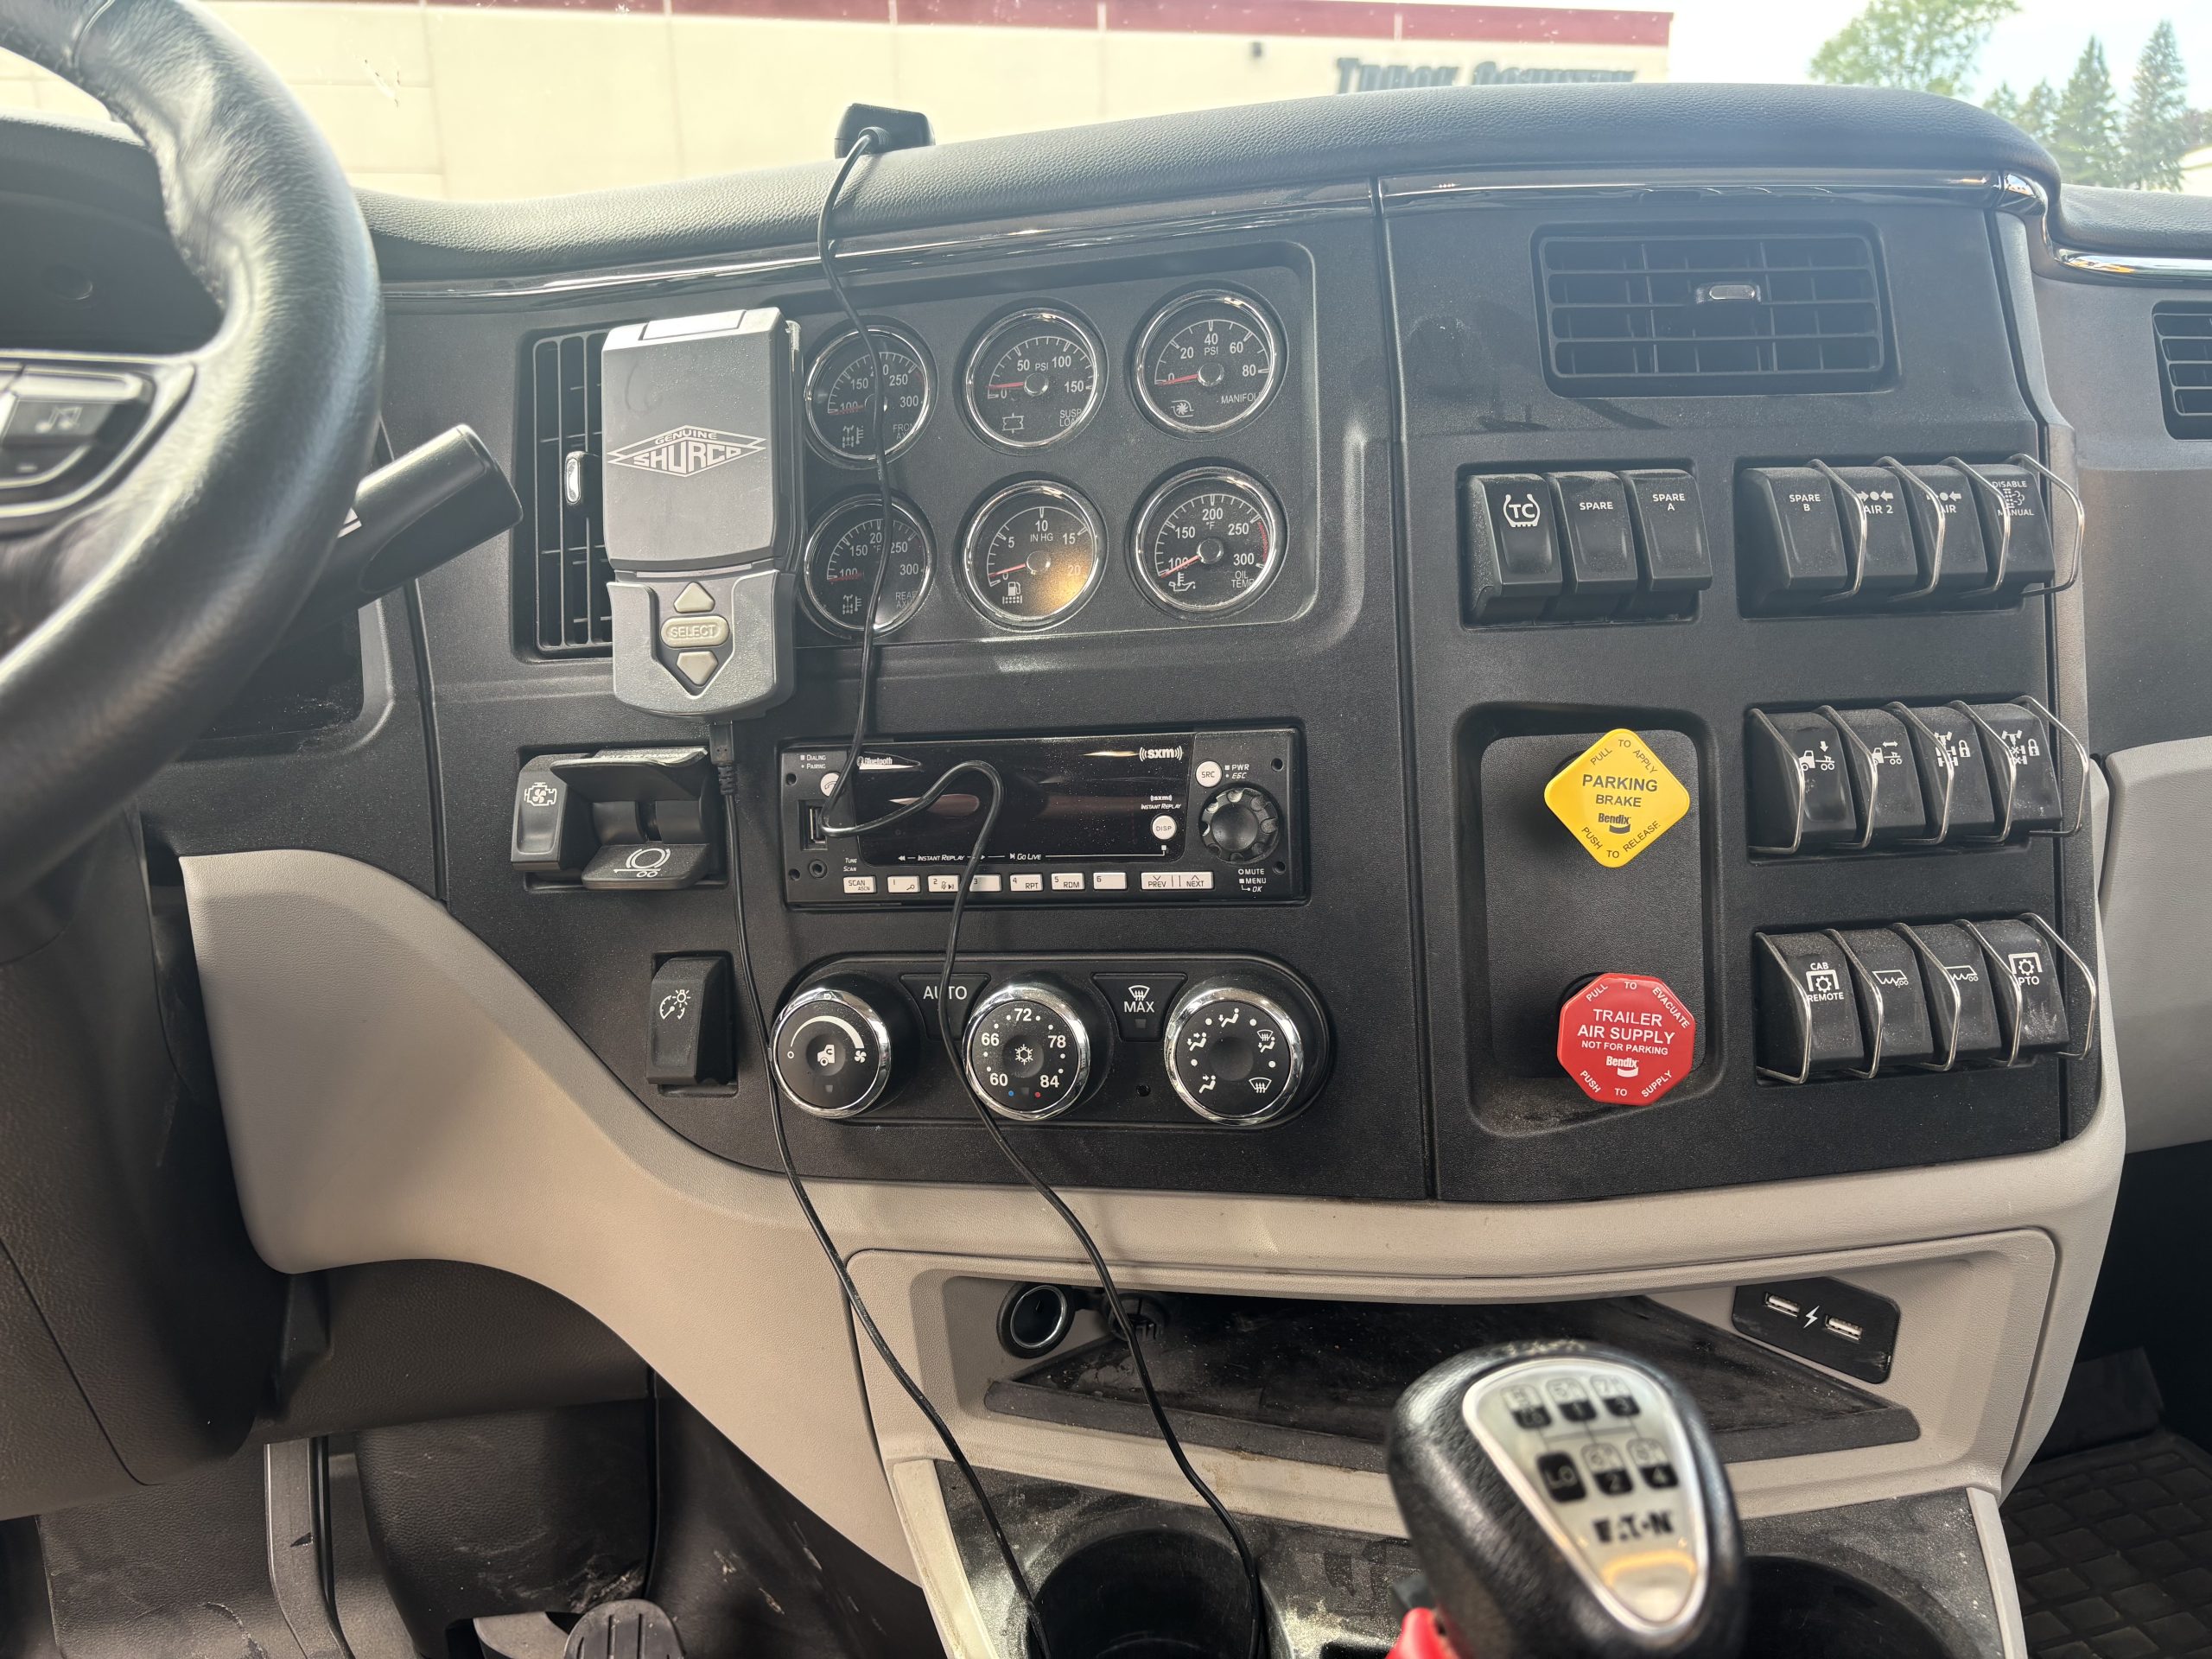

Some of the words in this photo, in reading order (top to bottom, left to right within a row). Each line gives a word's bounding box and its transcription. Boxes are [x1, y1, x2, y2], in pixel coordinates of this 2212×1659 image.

[1204, 333, 1218, 346] 40
[1180, 346, 1194, 359] 20
[1204, 346, 1218, 356] PSI
[1230, 341, 1243, 353] 60
[1017, 359, 1030, 372] 50
[1035, 362, 1049, 372] PSI
[1052, 355, 1071, 368] 100
[1243, 365, 1256, 377] 80
[851, 378, 868, 390] 150
[889, 374, 908, 386] 250
[1065, 380, 1084, 393] 150
[899, 396, 918, 408] 300
[1221, 392, 1262, 404] MANIFOL
[654, 429, 718, 445] GENUINE
[633, 441, 741, 474] SHURCO
[1509, 504, 1535, 518] TC
[1580, 501, 1613, 510] SPARE
[1667, 503, 1675, 512] A
[1864, 505, 1883, 514] AIR
[1886, 505, 1893, 514] 2
[1202, 508, 1224, 520] 200
[1035, 519, 1048, 532] 10
[1228, 523, 1249, 536] 250
[870, 532, 882, 544] 20
[1031, 534, 1038, 543] IN
[1040, 533, 1054, 542] HG
[1175, 526, 1195, 539] 150
[1007, 537, 1015, 549] 5
[1062, 533, 1076, 545] 15
[850, 544, 868, 556] 150
[1233, 553, 1255, 566] 300
[899, 563, 918, 575] 300
[1068, 565, 1081, 576] 20
[1235, 570, 1249, 580] OIL
[671, 625, 716, 638] SELECT
[865, 757, 893, 766] Bluetooth
[1590, 747, 1612, 766] PULL
[1618, 739, 1631, 748] TO
[1632, 749, 1658, 774] APPLY
[1582, 773, 1658, 792] PARKING
[1596, 794, 1642, 807] BRAKE
[1599, 813, 1630, 825] Bendix
[1581, 827, 1603, 849] PUSH
[1606, 849, 1619, 859] TO
[1623, 820, 1661, 852] RELEASE
[1810, 962, 1829, 970] CAB
[2018, 976, 2040, 986] PTO
[1807, 992, 1845, 1002] REMOTE
[1123, 1001, 1155, 1013] MAX
[1586, 983, 1609, 1001] PULL
[1624, 981, 1637, 990] TO
[1652, 987, 1690, 1029] EVACUATE
[1014, 1008, 1032, 1021] 72
[1593, 1008, 1662, 1027] TRAILER
[981, 1033, 1000, 1046] 66
[1577, 1025, 1605, 1038] AIR
[1610, 1027, 1675, 1045] SUPPLY
[1048, 1035, 1066, 1049] 78
[1581, 1040, 1602, 1049] NOT
[1604, 1042, 1624, 1051] FOR
[1625, 1044, 1669, 1055] PARKING
[1606, 1056, 1637, 1068] Bendix
[989, 1073, 1008, 1086] 60
[1040, 1075, 1059, 1088] 84
[1580, 1071, 1601, 1093] PUSH
[1615, 1088, 1627, 1096] TO
[1641, 1070, 1672, 1097] SUPPLY
